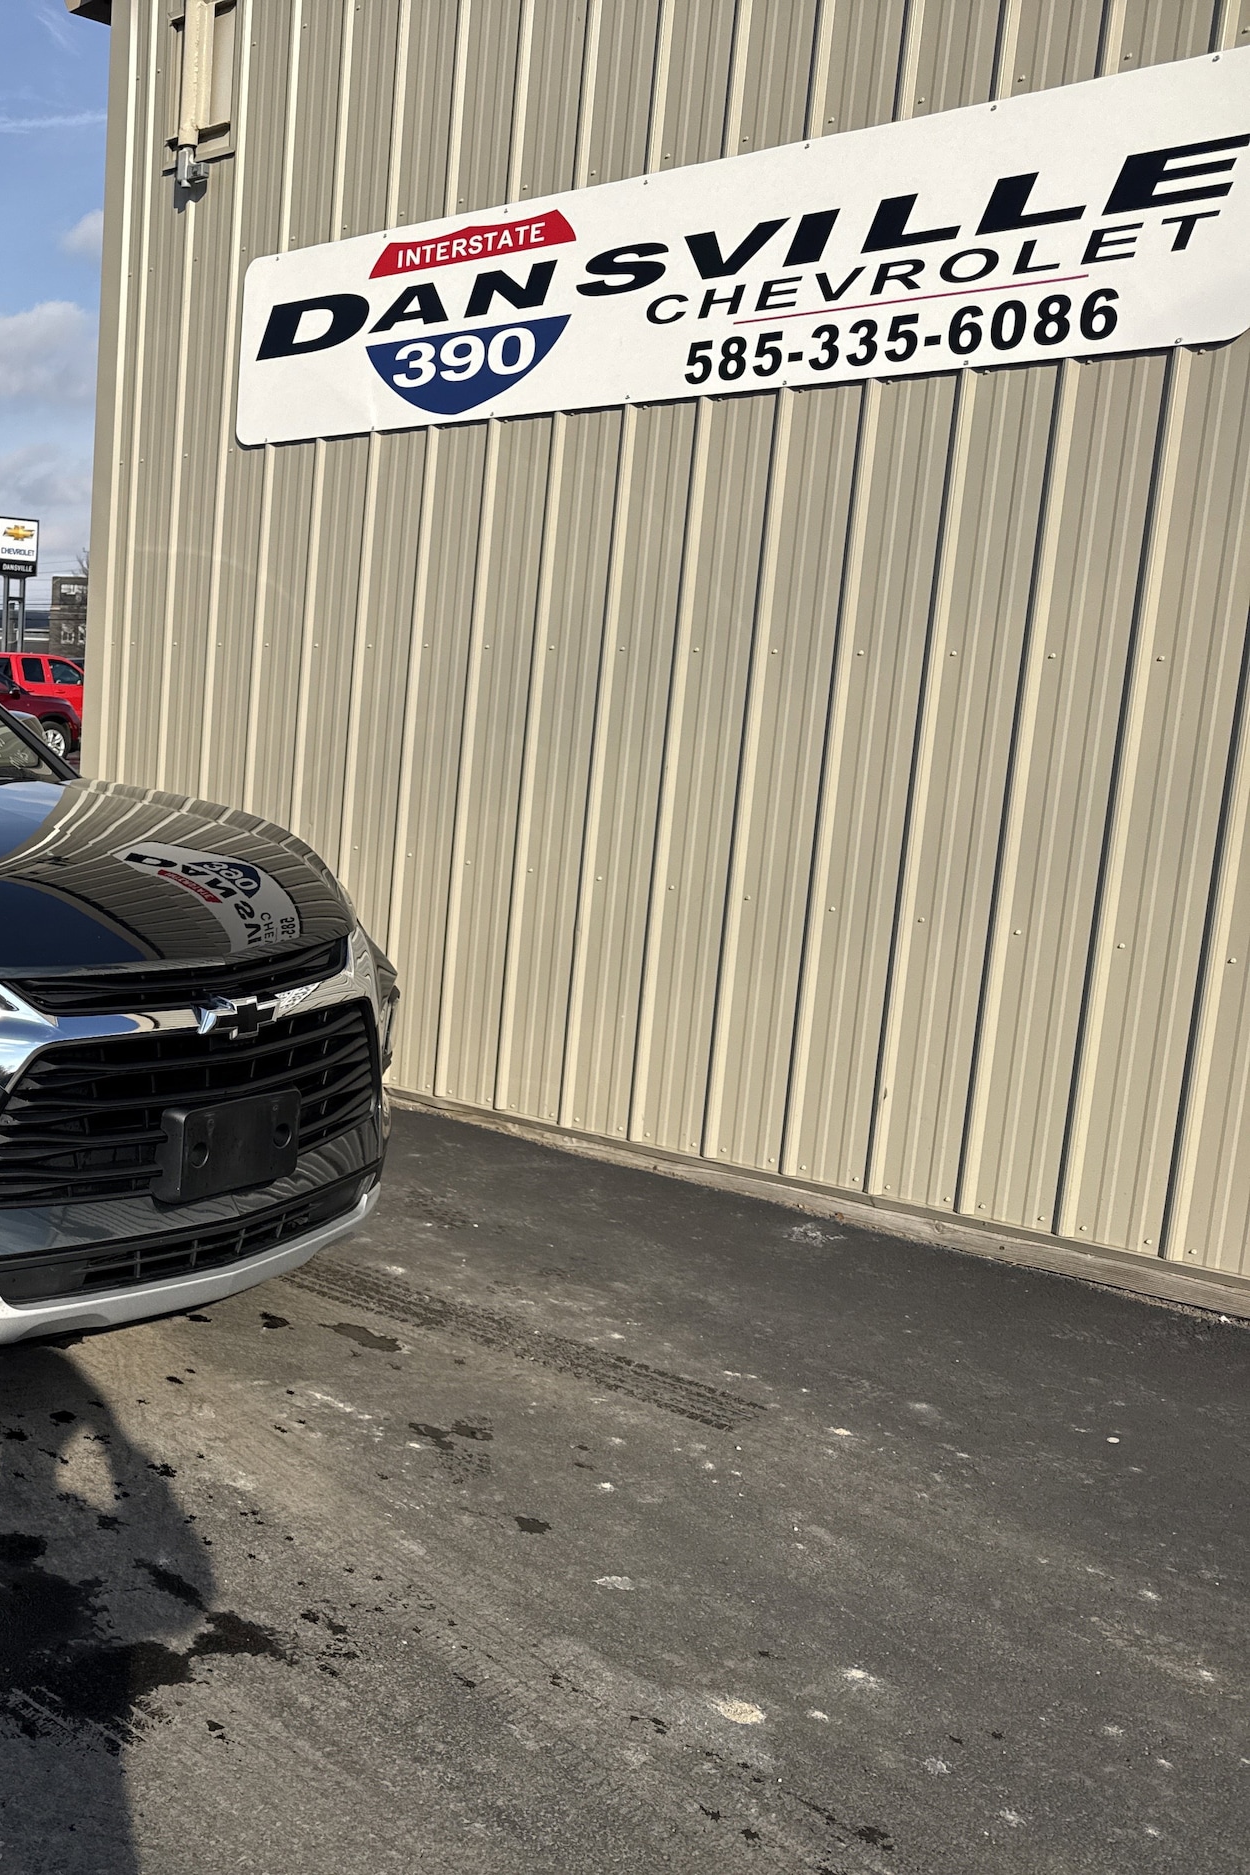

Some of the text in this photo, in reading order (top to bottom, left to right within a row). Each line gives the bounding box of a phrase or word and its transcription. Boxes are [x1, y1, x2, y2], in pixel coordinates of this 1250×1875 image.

[255, 133, 1250, 362] DANSVILLE
[396, 221, 546, 270] INTERSTATE
[646, 209, 1221, 325] CHEVROLET
[391, 327, 536, 389] 390
[684, 287, 1120, 385] 585-335-6086
[1, 547, 34, 556] CHEVROLET
[2, 563, 33, 572] DANSVILLE
